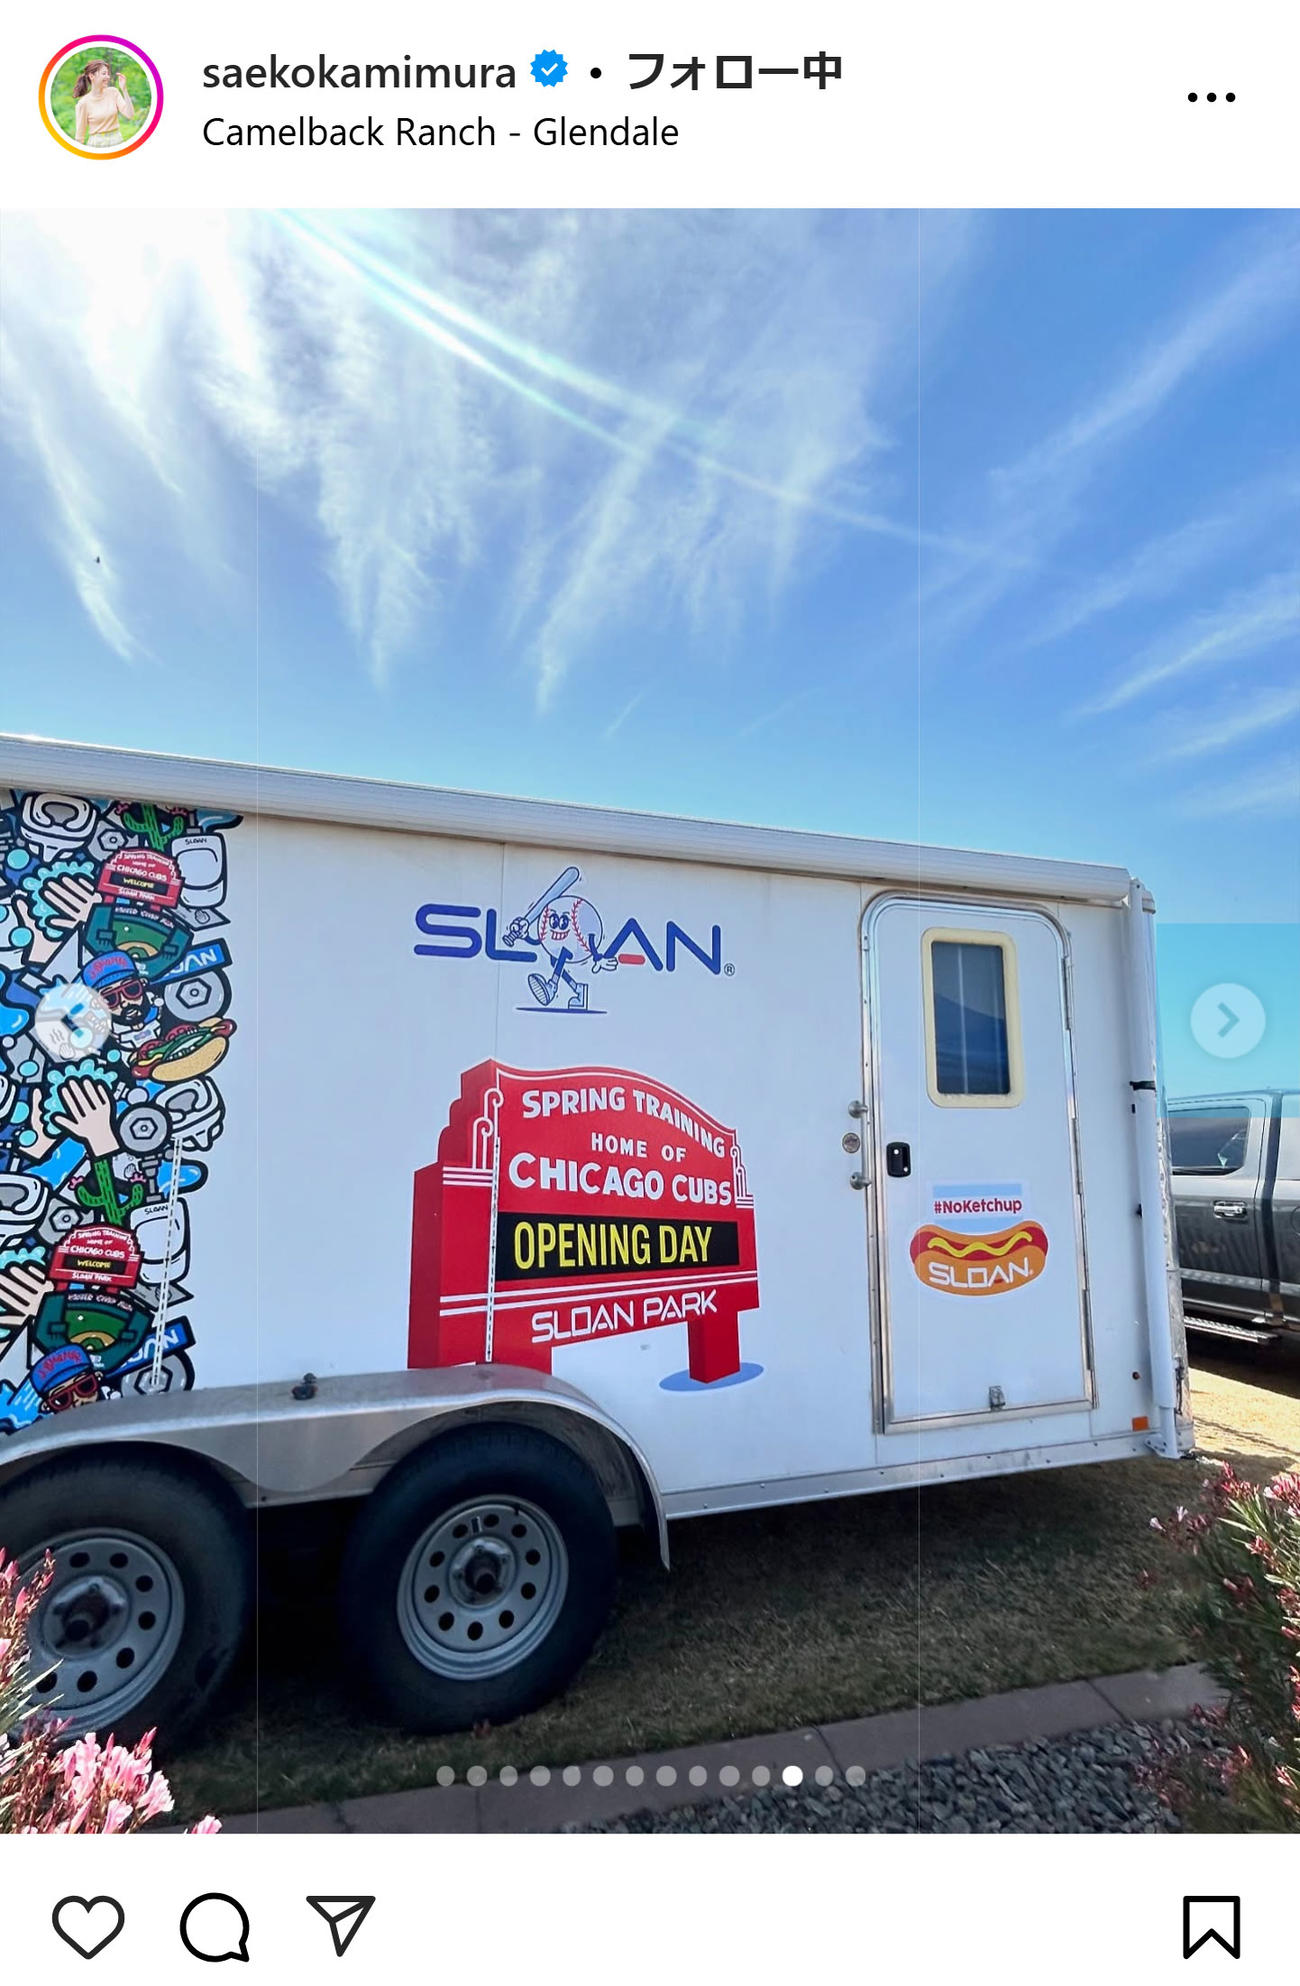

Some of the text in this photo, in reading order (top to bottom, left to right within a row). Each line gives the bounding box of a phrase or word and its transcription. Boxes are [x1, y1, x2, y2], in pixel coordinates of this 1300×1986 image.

[117, 865, 167, 881] CHICAGO CUBS
[123, 877, 155, 889] WELCOME
[522, 1086, 725, 1158] SPRING TRAINING
[591, 1132, 687, 1162] HOME OF
[508, 1152, 732, 1206] CHICAGO CUBS
[144, 1204, 168, 1214] SLOAN
[934, 1198, 1022, 1214] #NoKetchup
[70, 1245, 125, 1259] CHICAGO CUBS
[514, 1221, 712, 1270] OPENING DAY
[77, 1259, 111, 1269] WELCOME
[928, 1257, 1029, 1288] SLOAN
[531, 1289, 717, 1343] SLOAN PARK
